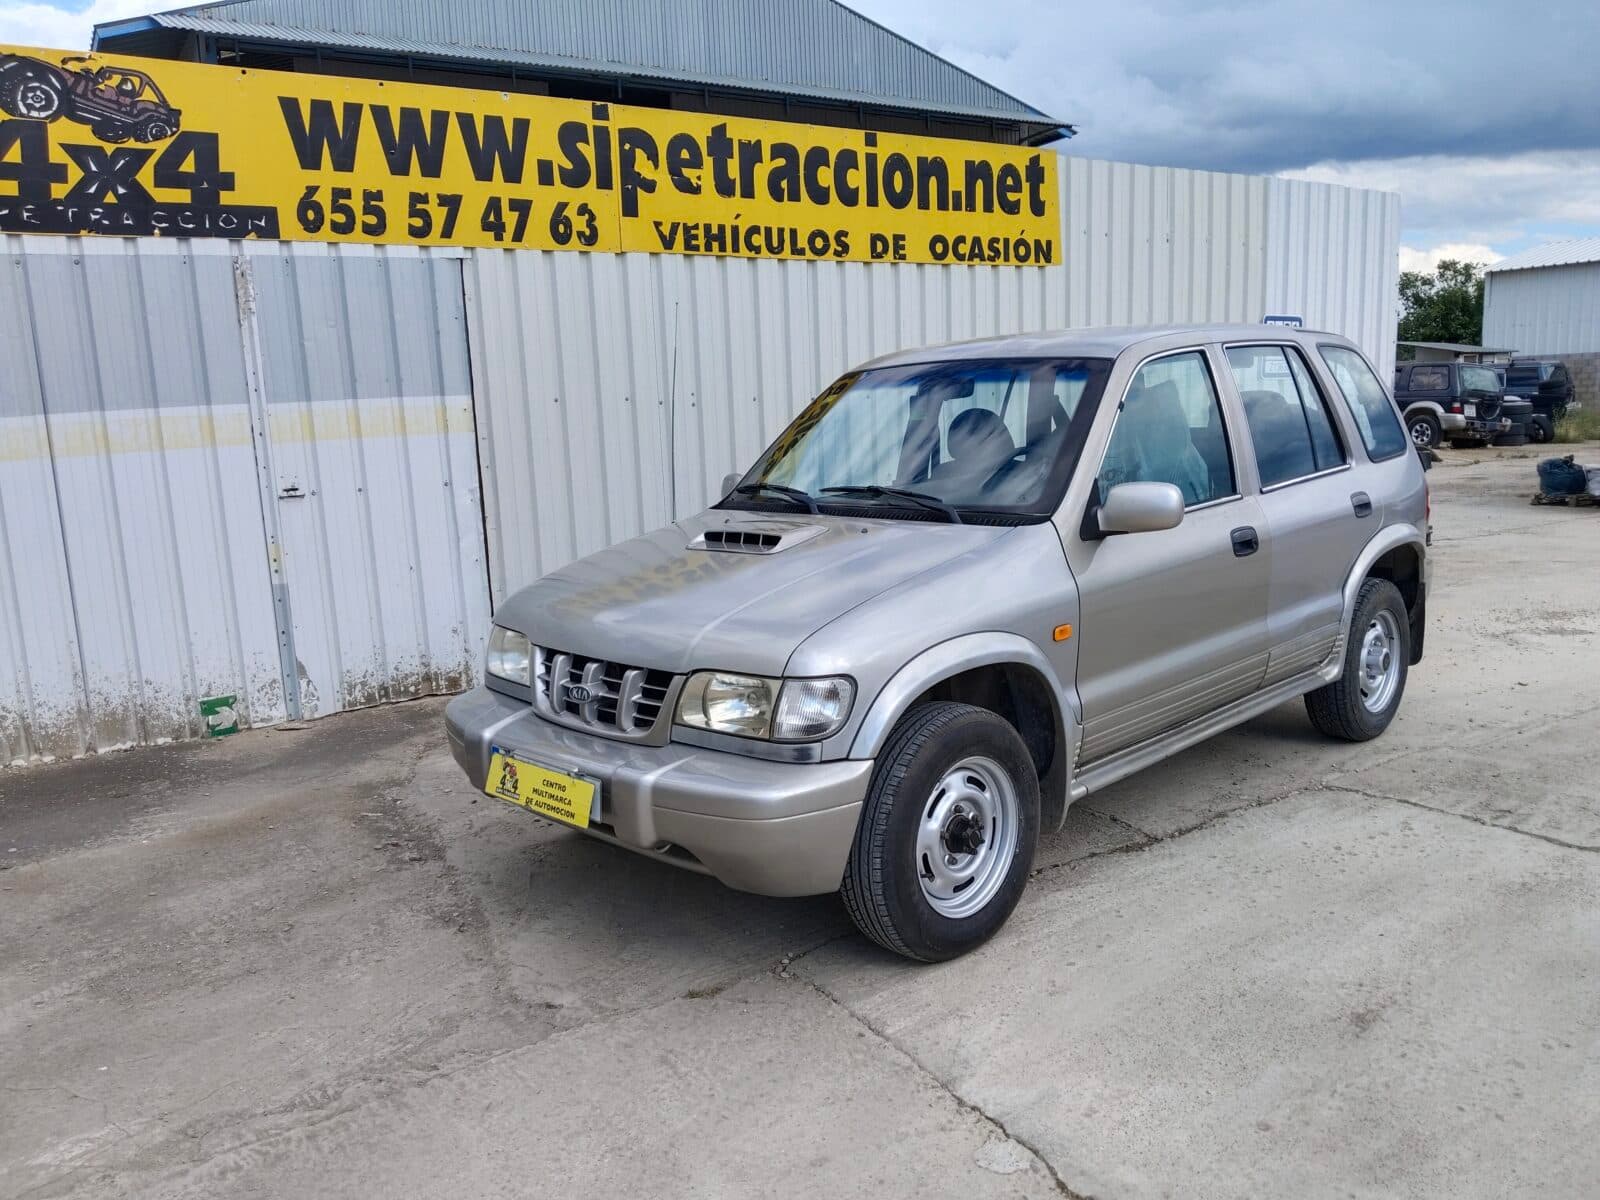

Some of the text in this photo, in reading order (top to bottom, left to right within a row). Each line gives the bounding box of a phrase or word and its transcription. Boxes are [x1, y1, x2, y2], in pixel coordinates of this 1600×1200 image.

[0, 119, 235, 205] 4x4
[278, 96, 1046, 218] www.sipetraccion.net
[297, 185, 599, 246] 655 57 47 63
[652, 213, 1053, 264] VEHÍCULOS DE OCASIÓN
[572, 687, 589, 700] KIA
[532, 787, 572, 806] MULTIMARCA
[542, 779, 567, 792] CENTRO
[525, 796, 576, 820] DE AUTOMOCION
